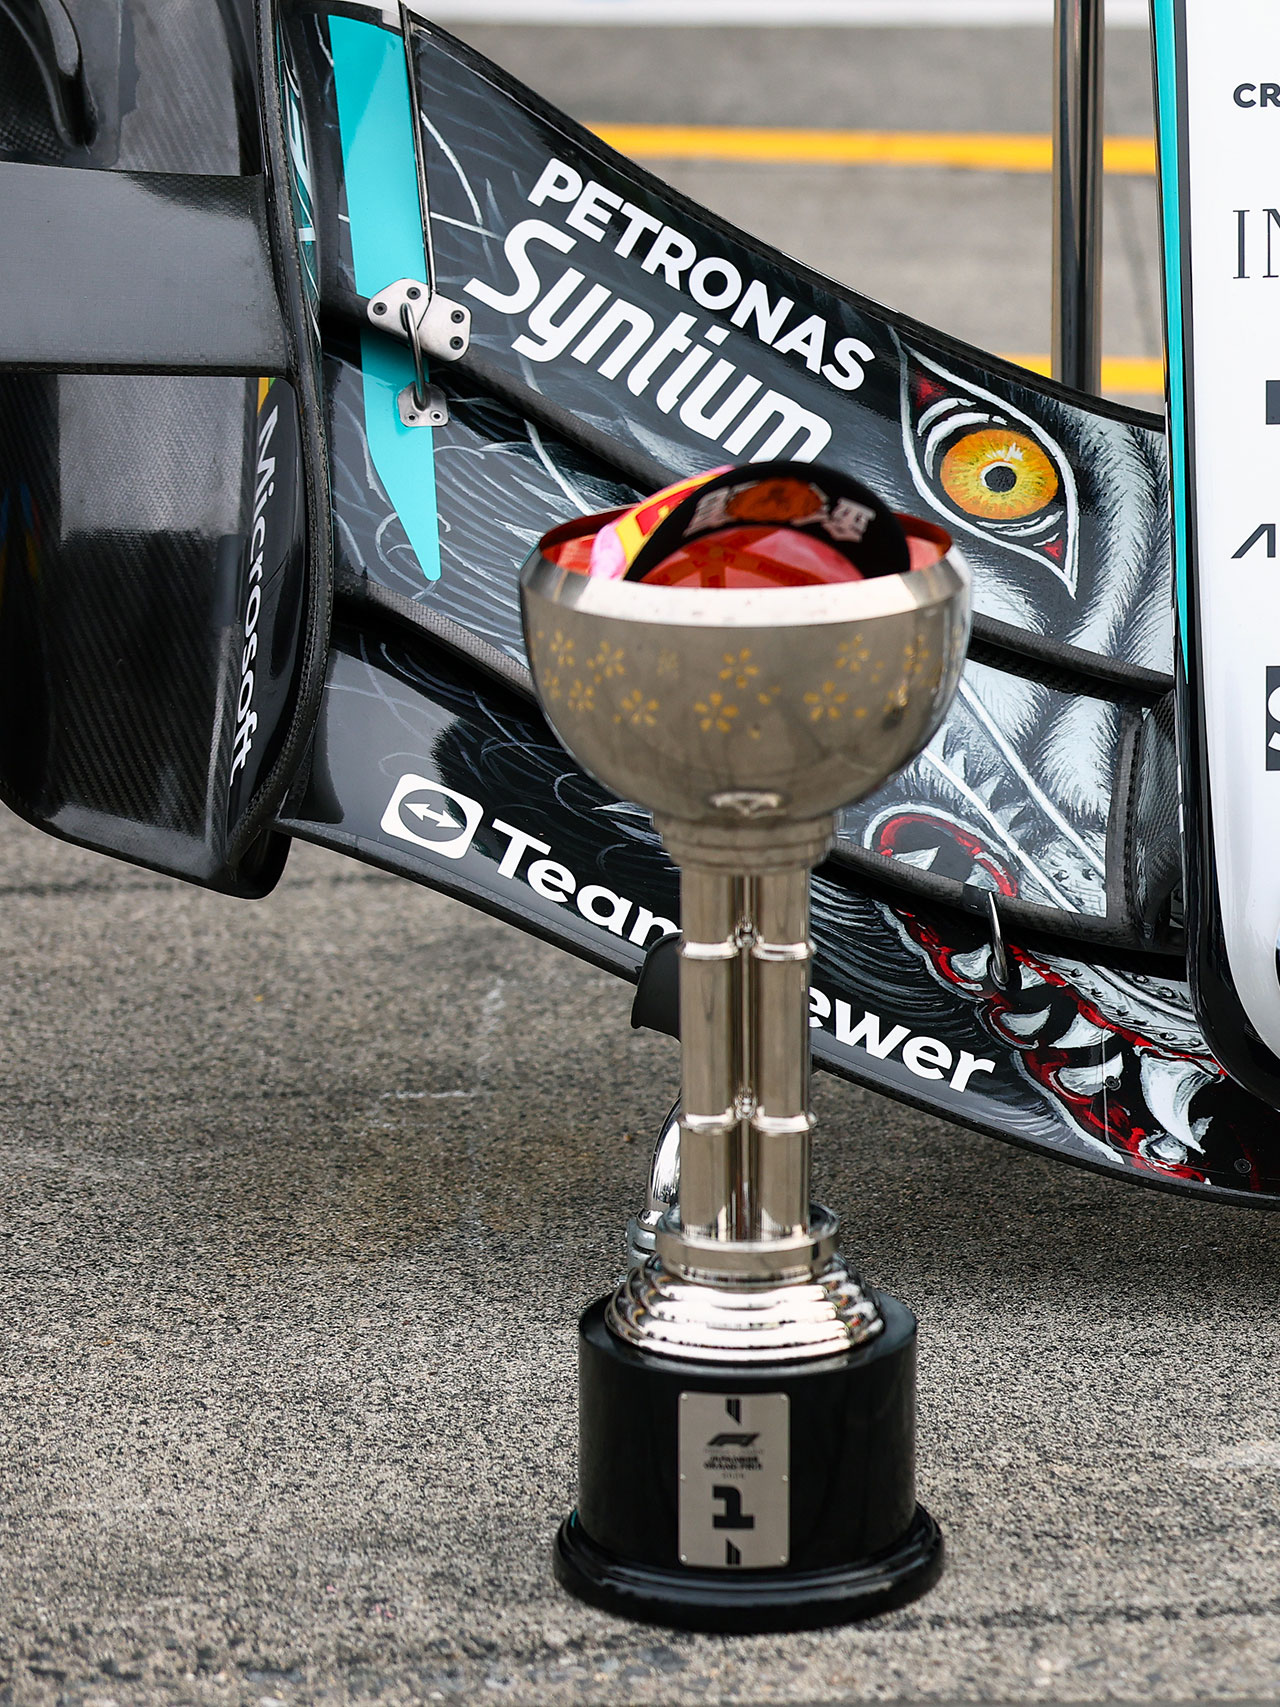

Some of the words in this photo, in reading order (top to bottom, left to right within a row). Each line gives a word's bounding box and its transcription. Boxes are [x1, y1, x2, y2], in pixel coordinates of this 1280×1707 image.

[462, 219, 833, 463] Syntium
[527, 157, 876, 391] PETRONAS
[229, 404, 279, 787] Microsoft
[712, 1484, 755, 1530] 1
